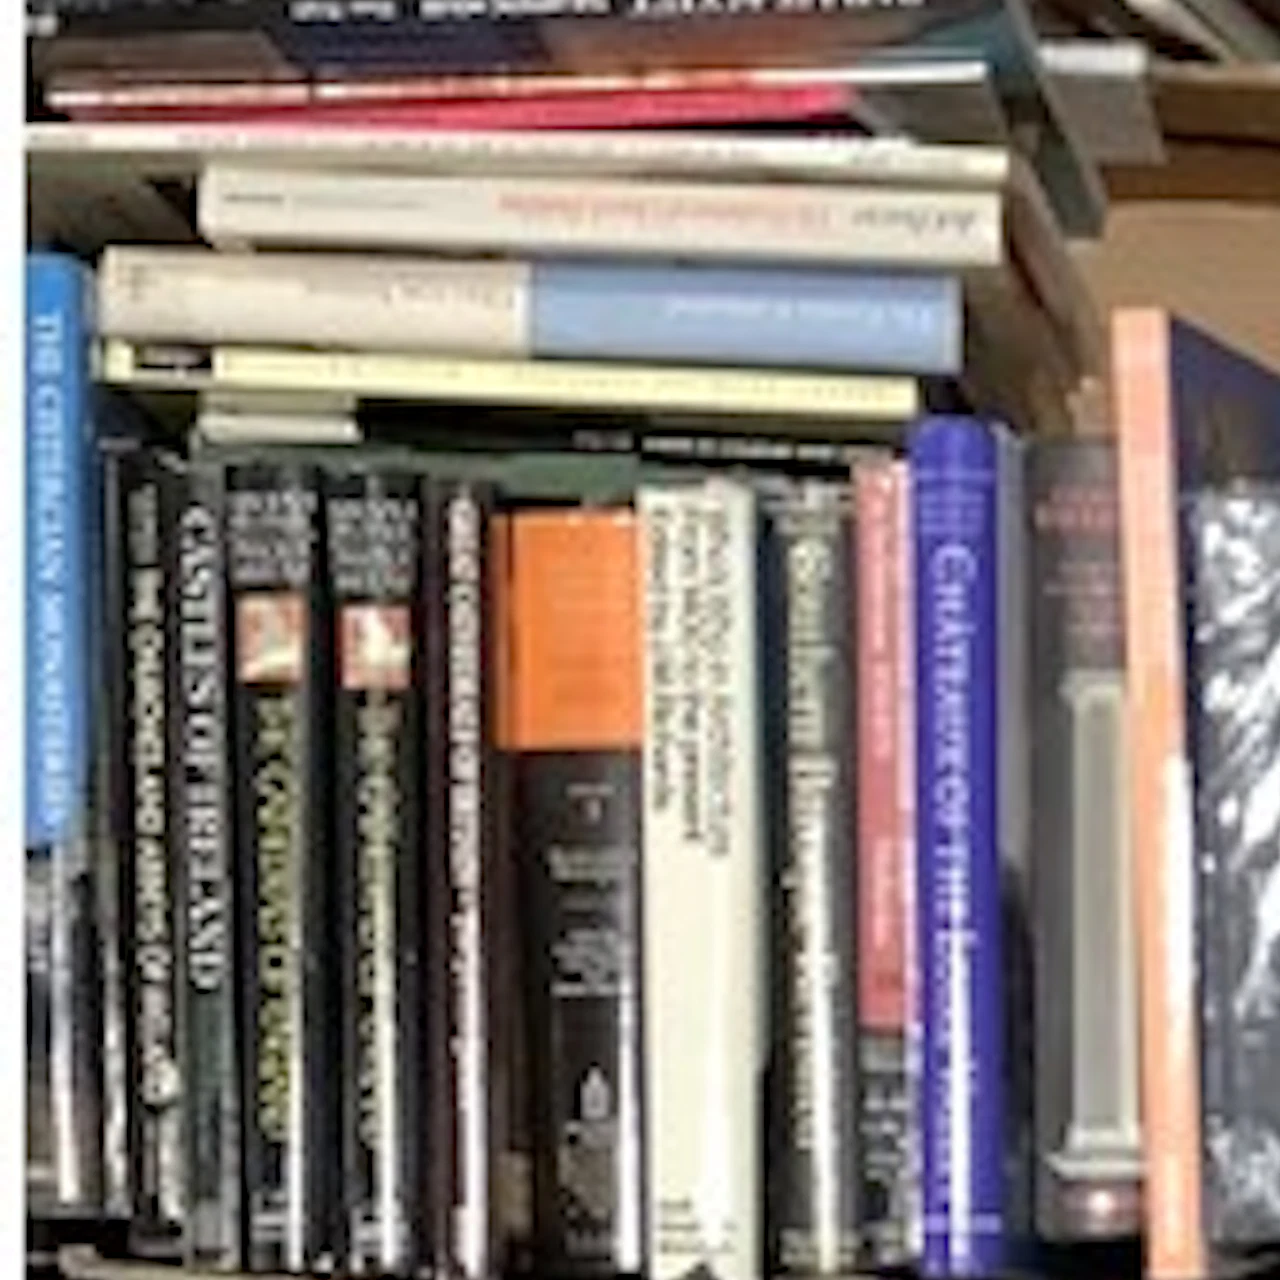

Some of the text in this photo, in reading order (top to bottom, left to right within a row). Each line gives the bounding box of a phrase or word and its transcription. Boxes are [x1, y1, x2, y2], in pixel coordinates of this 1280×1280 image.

[33, 311, 63, 374] THE
[180, 508, 225, 989] CASTLES OF IRELAND
